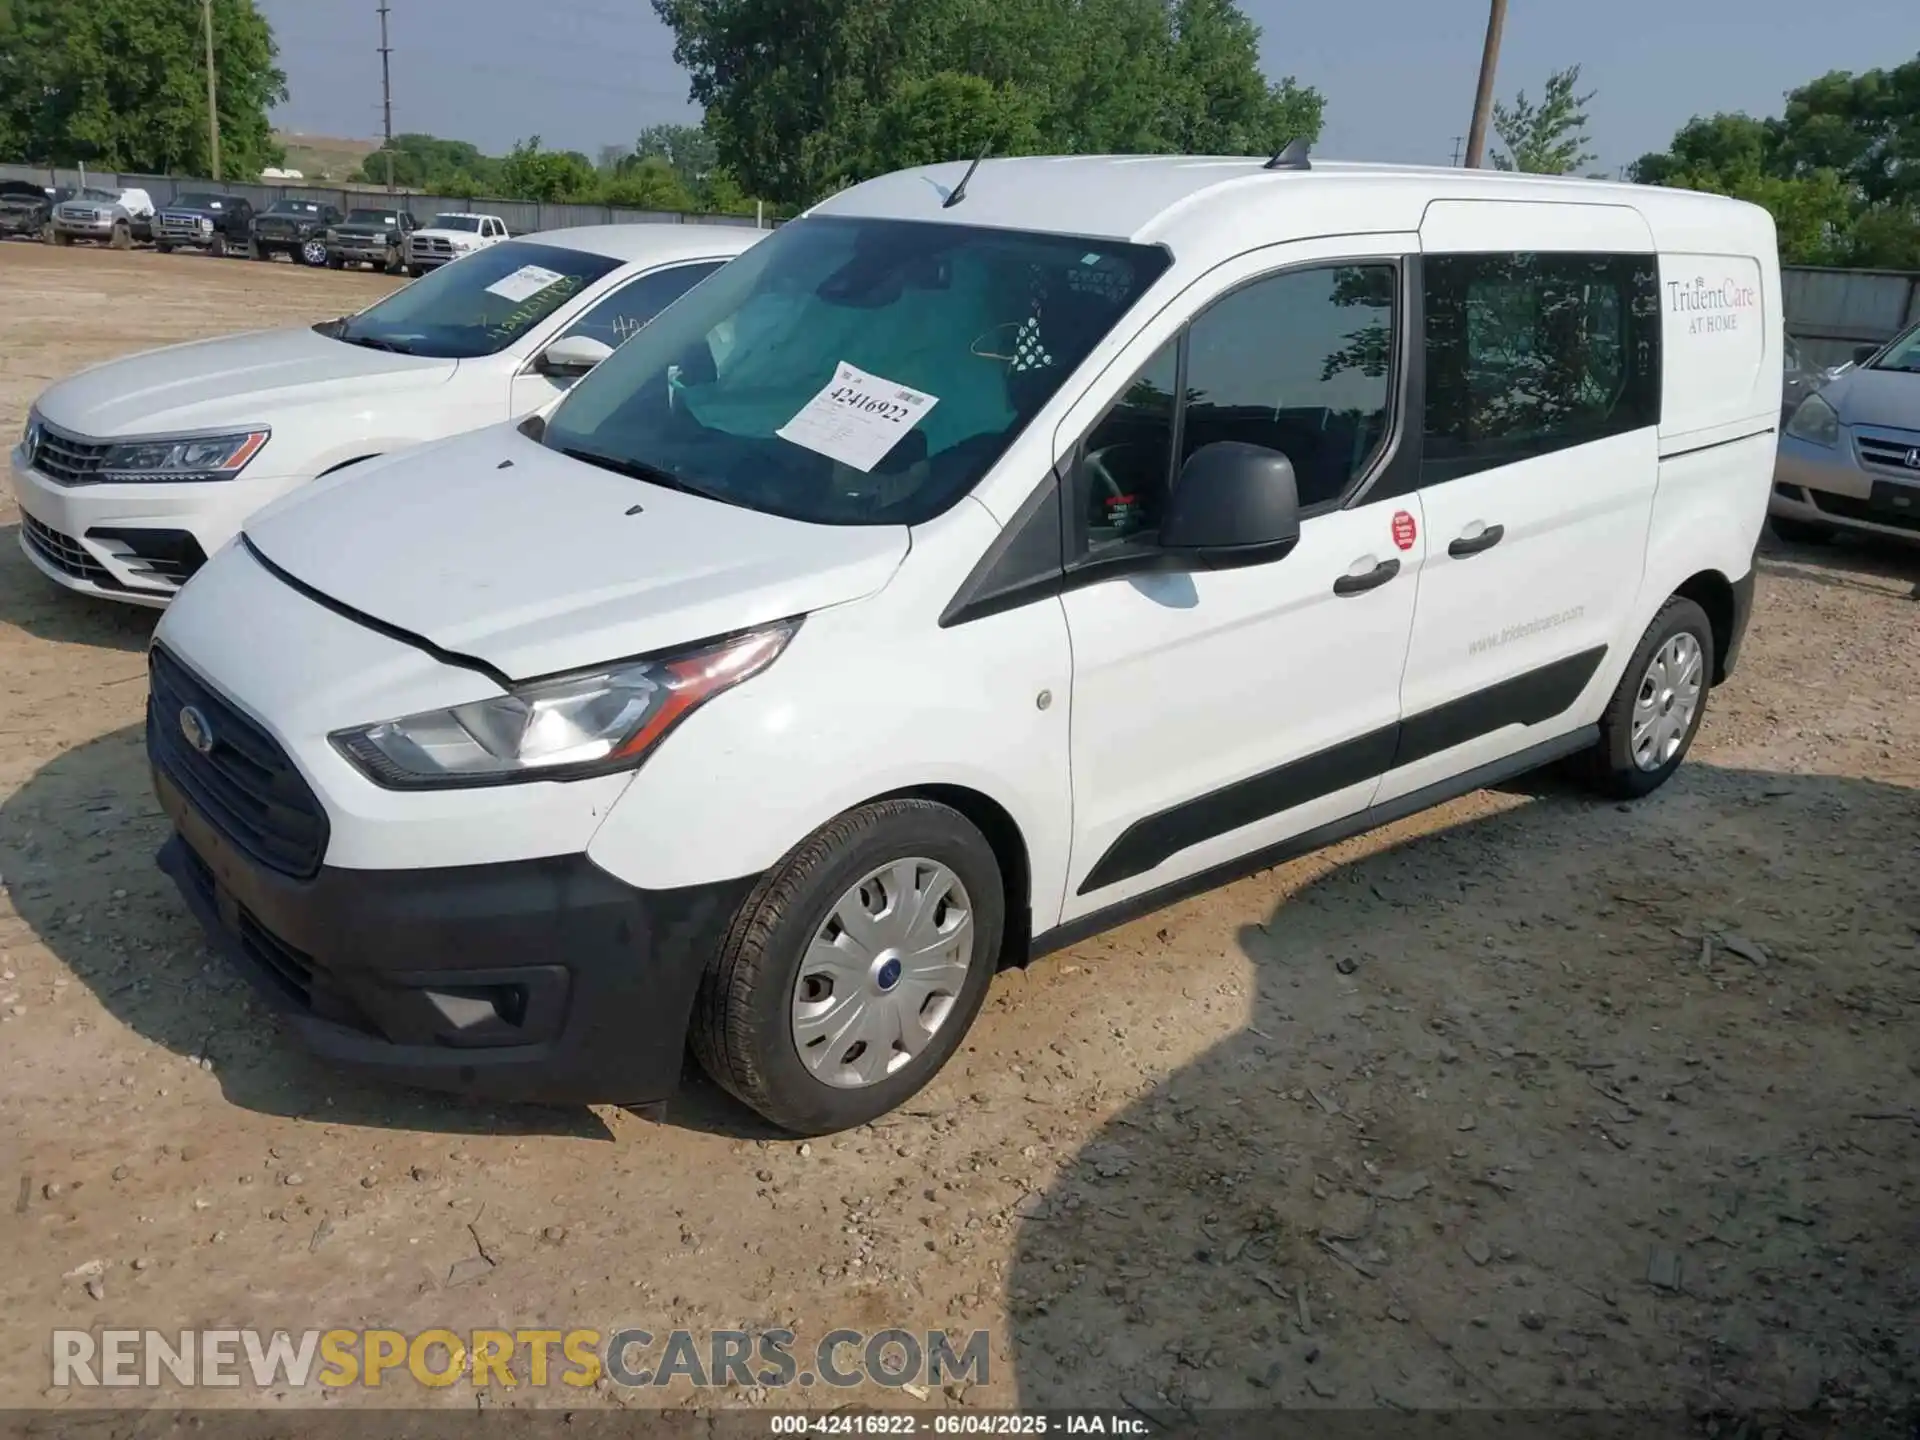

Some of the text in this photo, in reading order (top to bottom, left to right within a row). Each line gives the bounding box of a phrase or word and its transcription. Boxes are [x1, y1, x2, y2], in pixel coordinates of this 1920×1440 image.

[1667, 276, 1754, 312] TridentCare
[1689, 314, 1737, 334] AT HOME
[830, 386, 909, 423] 42416922
